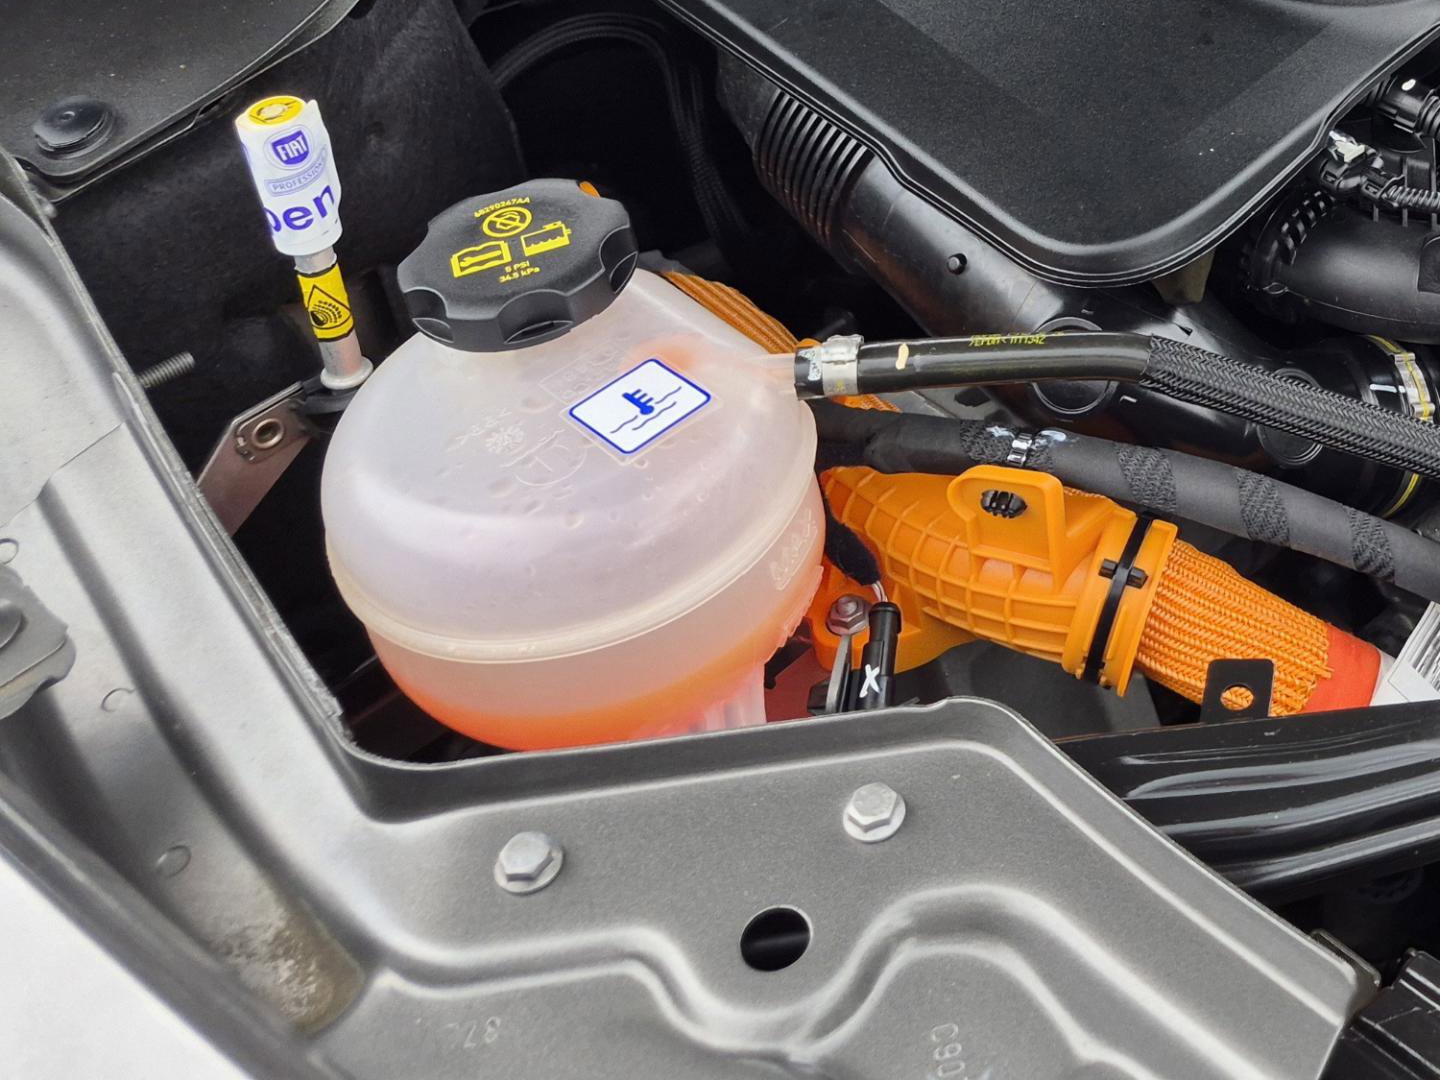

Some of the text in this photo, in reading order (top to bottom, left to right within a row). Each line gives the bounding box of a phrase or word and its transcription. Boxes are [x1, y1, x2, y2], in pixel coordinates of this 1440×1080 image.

[276, 134, 307, 161] FIAT
[513, 260, 530, 271] PSI
[520, 267, 540, 278] kPa
